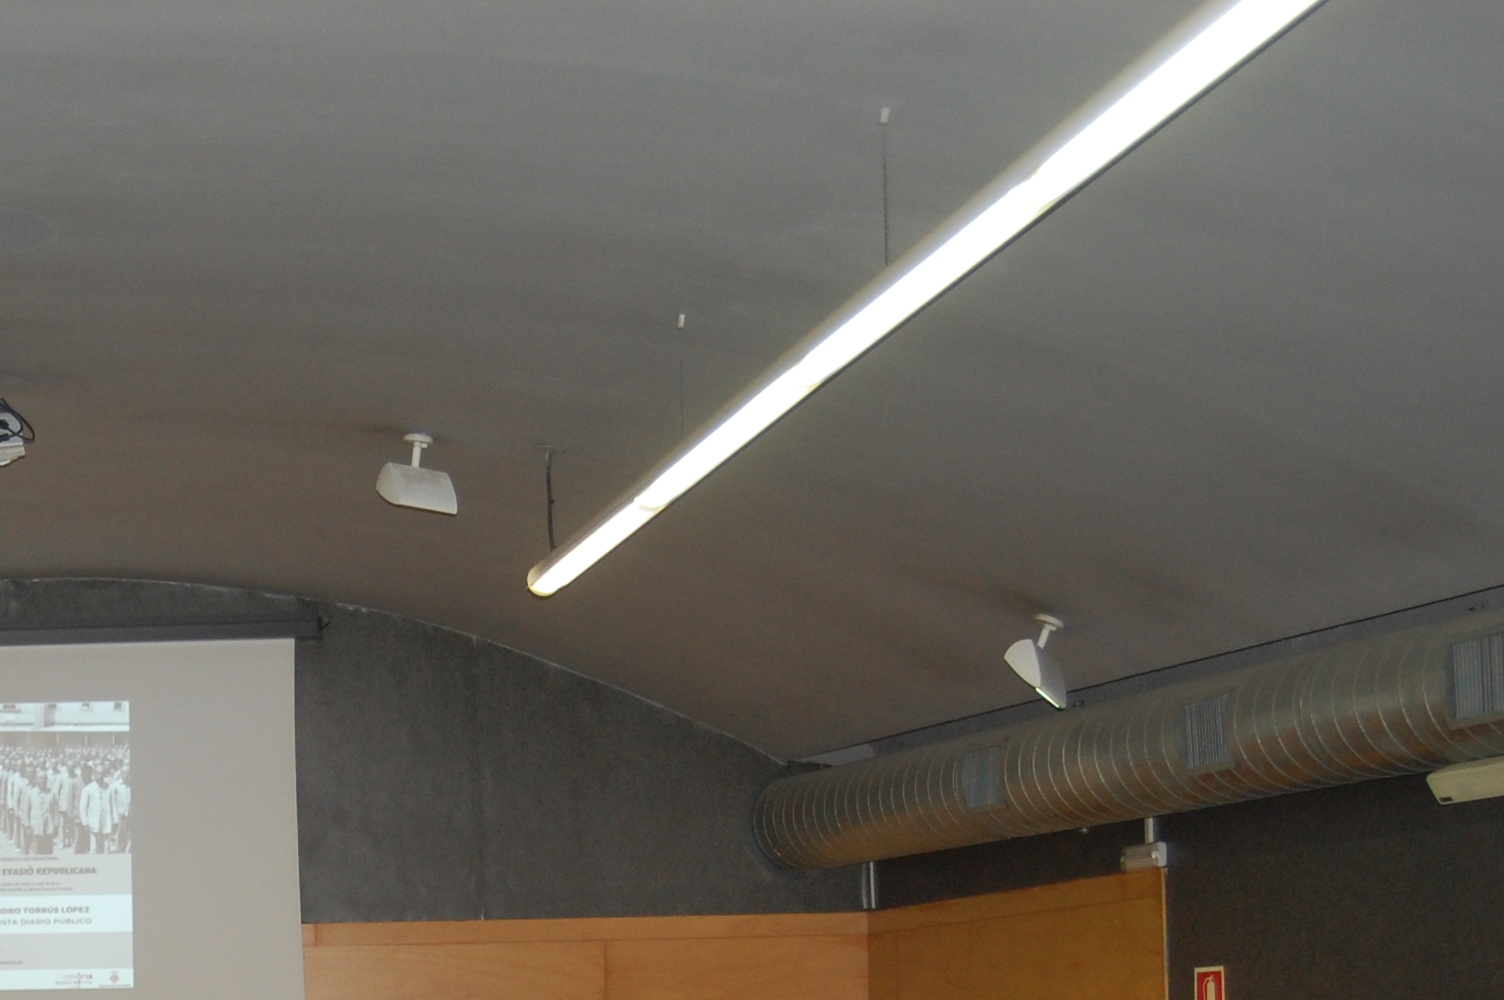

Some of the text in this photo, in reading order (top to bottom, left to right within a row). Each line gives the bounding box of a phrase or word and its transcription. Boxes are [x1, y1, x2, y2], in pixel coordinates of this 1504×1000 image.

[2, 865, 34, 876] EVASIÓ
[36, 866, 97, 875] REPUBLICANA
[24, 906, 59, 914] TORRÚS
[61, 905, 90, 913] LÓPEZ
